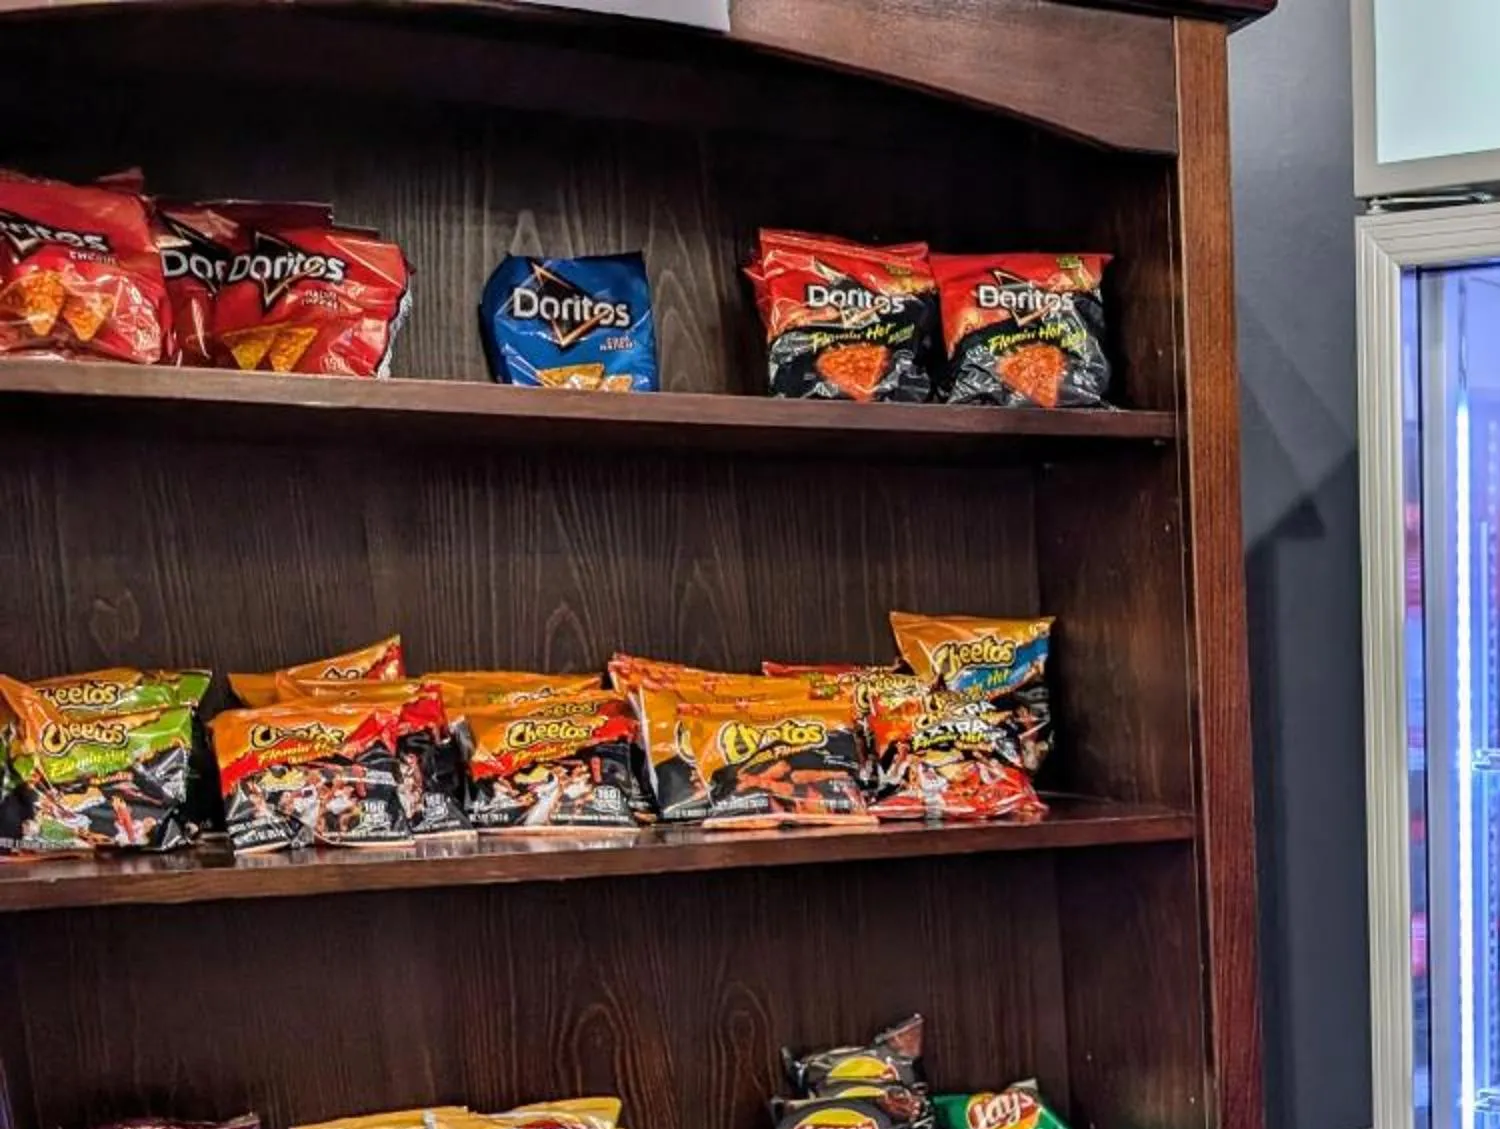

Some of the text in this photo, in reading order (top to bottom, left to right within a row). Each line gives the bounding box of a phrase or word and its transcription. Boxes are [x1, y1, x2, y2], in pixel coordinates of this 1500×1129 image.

[228, 252, 346, 282] Doritos
[512, 287, 631, 328] Doritos
[807, 285, 905, 315] Doritos
[978, 284, 1076, 313] Doritos
[43, 721, 123, 753] Cheetos
[509, 720, 590, 746] Cheetos
